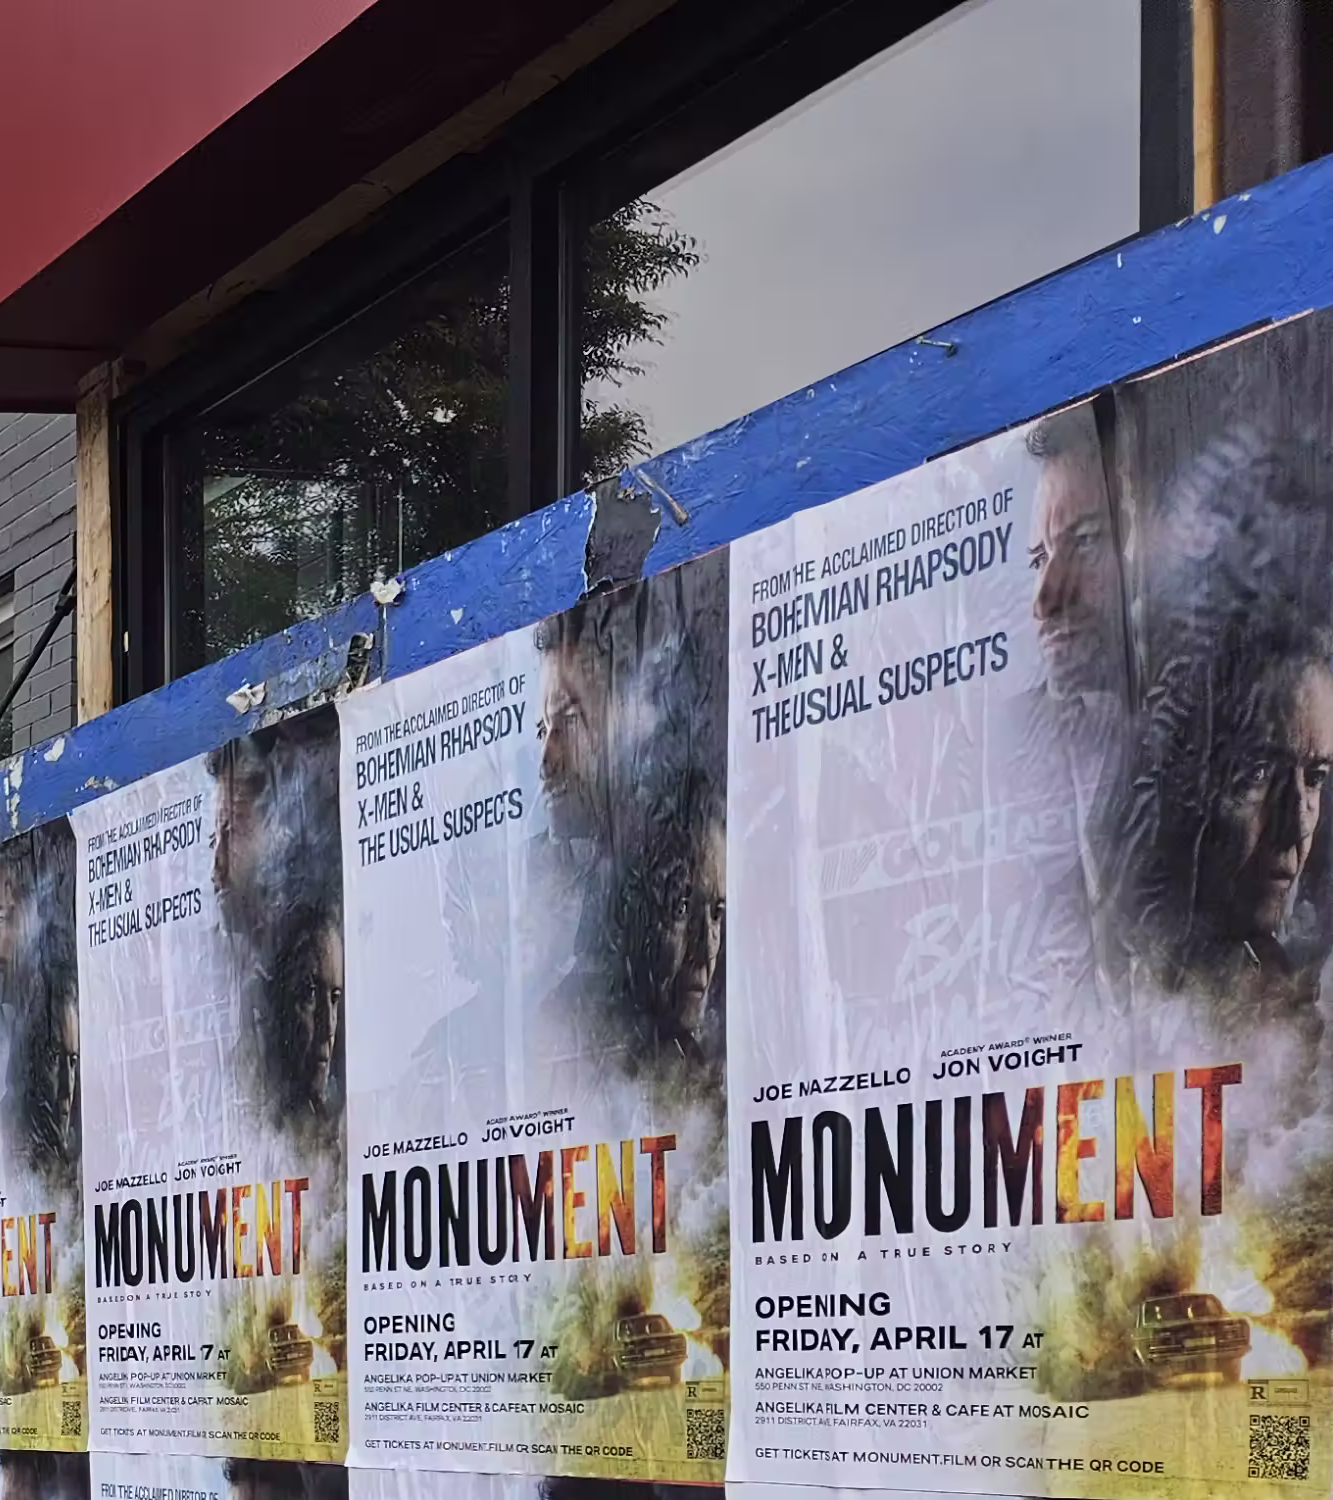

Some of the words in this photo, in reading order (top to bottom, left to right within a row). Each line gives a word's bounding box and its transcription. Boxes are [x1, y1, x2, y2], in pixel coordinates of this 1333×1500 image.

[752, 572, 791, 604] FROM
[821, 530, 906, 579] ACCLAIMED
[911, 498, 988, 548] DIRECTOR
[993, 488, 1014, 515] OF
[752, 575, 870, 649] BOHEMIAN
[876, 523, 1014, 607] RHAPSODY
[752, 638, 823, 698] X-MEN
[830, 634, 849, 670] &
[752, 699, 791, 744] THE
[792, 678, 871, 730] USUAL
[878, 632, 1009, 707] SUSPECTS
[357, 735, 435, 789] BOHEMIAN
[441, 702, 526, 761] RHAPSODY
[358, 786, 407, 829] X-MEN
[412, 781, 423, 811] &
[358, 832, 385, 867] THE
[389, 817, 439, 857] USUAL
[88, 844, 141, 883] BOHEMIAN
[753, 1080, 792, 1103] JOE
[933, 1054, 980, 1080] JON
[987, 1044, 1082, 1074] VOIGHT
[751, 1063, 1242, 1243] MONUMENT
[362, 1134, 676, 1273] MONUMENT
[94, 1178, 309, 1288] MONUMENT
[755, 1253, 812, 1265] BASED
[821, 1251, 839, 1262] ON
[858, 1250, 867, 1260] A
[881, 1246, 931, 1259] TRUE
[944, 1242, 1012, 1255] STORY
[756, 1292, 891, 1319] OPENING
[364, 1312, 455, 1335] OPENING
[756, 1328, 860, 1353] FRIDAY,
[870, 1326, 967, 1350] APRIL
[979, 1325, 1014, 1349] 17
[1022, 1333, 1044, 1348] AT
[99, 1346, 149, 1363] FRIDAY,
[364, 1342, 437, 1363] FRIDAY,
[444, 1340, 506, 1359] APRIL
[755, 1367, 824, 1379] ANGELIKA
[824, 1368, 884, 1379] POP-UP
[889, 1368, 908, 1379] AT
[912, 1367, 964, 1379] UNION
[969, 1367, 1037, 1379] MARKET
[755, 1383, 770, 1391] 550
[772, 1383, 799, 1391] PENN
[799, 1383, 809, 1391] ST
[897, 1383, 911, 1391] DC
[914, 1383, 943, 1391] 20002
[1250, 1387, 1265, 1399] R
[755, 1402, 824, 1414] ANGELIKA
[826, 1403, 859, 1415] FILM
[865, 1404, 927, 1416] CENTER
[932, 1404, 941, 1415] &
[946, 1404, 989, 1416] CAFE
[993, 1405, 1014, 1417] AT
[1019, 1405, 1089, 1418] MOSAIC
[778, 1417, 817, 1425] DISTRICT
[833, 1419, 881, 1428] FAIRFAX,
[883, 1420, 896, 1428] VA
[898, 1420, 927, 1428] 22031
[755, 1448, 779, 1458] GET
[783, 1448, 830, 1461] TICKETS
[832, 1451, 848, 1462] AT
[853, 1452, 976, 1466] MONUMENT.FILM
[981, 1456, 1001, 1467] OR
[1006, 1457, 1043, 1469] SCAN
[1046, 1459, 1083, 1470] THE
[1090, 1460, 1112, 1472] QR
[1117, 1461, 1164, 1473] CODE
